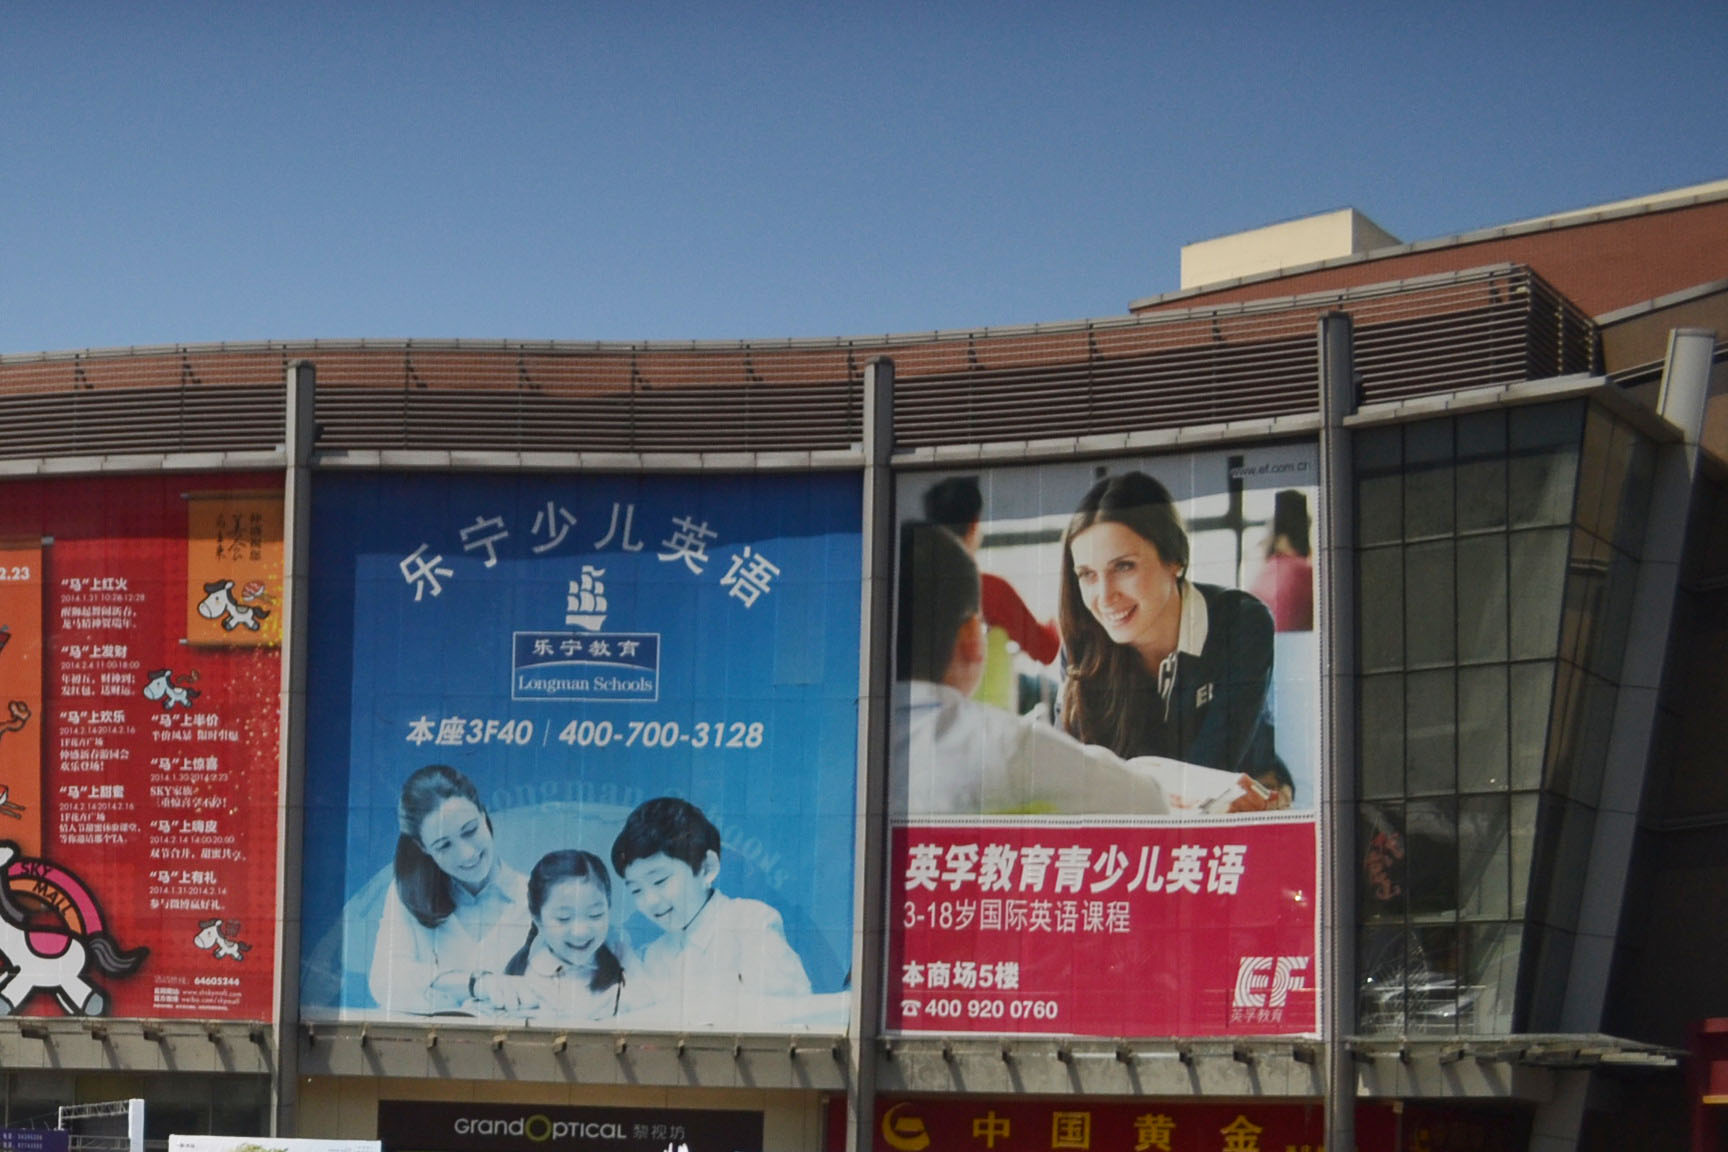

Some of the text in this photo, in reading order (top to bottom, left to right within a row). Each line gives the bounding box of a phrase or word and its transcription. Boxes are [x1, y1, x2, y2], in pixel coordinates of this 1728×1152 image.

[399, 500, 781, 609] 乐宁少儿英语
[532, 638, 641, 658] 乐宁教育
[518, 675, 654, 693] Longman Schools
[405, 715, 764, 749] 本座3F40 400-700-3128
[904, 842, 1247, 896] 英孚教育青少儿英语
[903, 897, 1131, 934] 3-18岁国际英语课程
[901, 960, 1021, 991] 本商场5楼
[1231, 956, 1309, 1008] EF
[925, 999, 1059, 1020] 400 920 0760
[1230, 1007, 1283, 1024] 英孚教育
[633, 1123, 686, 1141] 黎视坊
